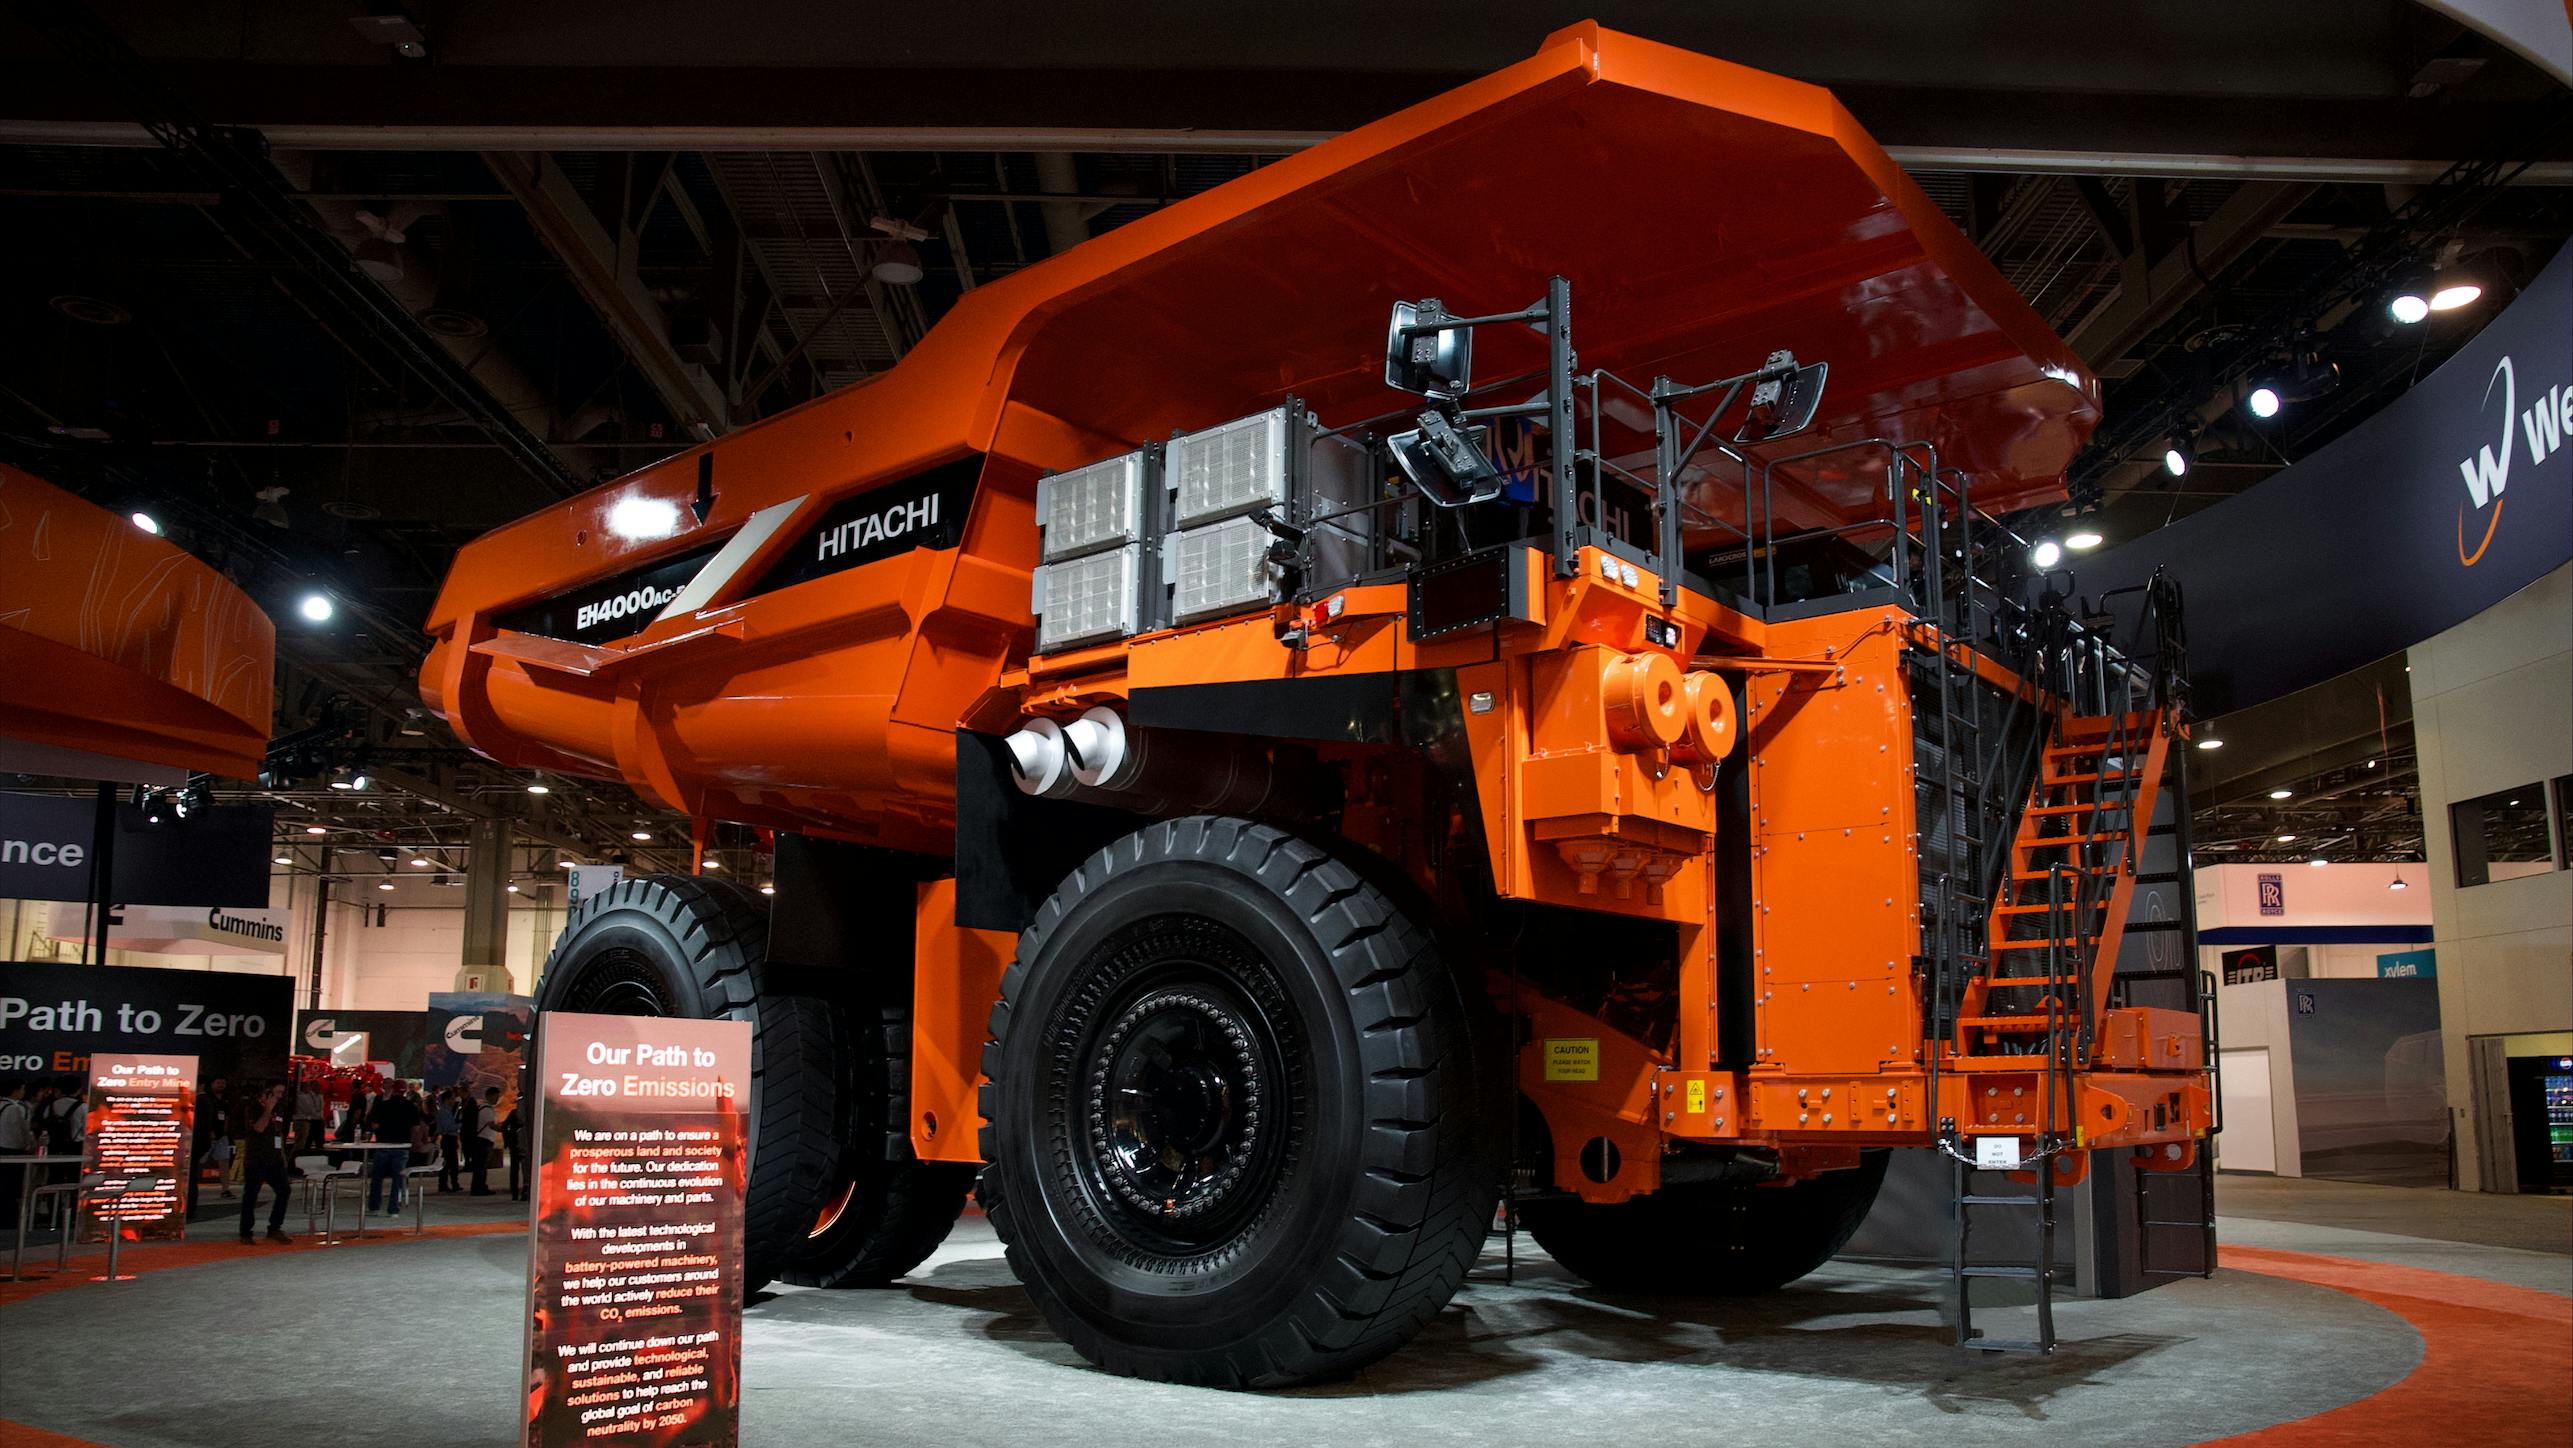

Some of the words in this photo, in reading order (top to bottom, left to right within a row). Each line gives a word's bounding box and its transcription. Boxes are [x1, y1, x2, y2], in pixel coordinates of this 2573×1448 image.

[818, 492, 939, 561] HITACHI
[1, 839, 84, 867] nce
[209, 906, 283, 942] Cummins
[2384, 960, 2417, 978] xylem
[0, 997, 102, 1032] Path
[117, 1003, 162, 1034] to
[174, 1004, 266, 1038] Zero
[587, 1042, 631, 1065] Our
[637, 1044, 687, 1067] Path
[693, 1047, 716, 1068] to
[1553, 1046, 1590, 1054] CAUTION
[112, 1065, 135, 1075] Our
[137, 1065, 165, 1076] Path
[167, 1066, 180, 1076] to
[97, 1077, 127, 1087] Zero
[129, 1078, 160, 1089] Entry
[162, 1079, 191, 1088] Mine
[560, 1073, 617, 1096] Zero
[623, 1075, 735, 1098] Emissions
[574, 1130, 592, 1142] We
[594, 1132, 611, 1141] are
[614, 1131, 628, 1141] on
[630, 1131, 637, 1141] a
[639, 1130, 662, 1143] path
[664, 1130, 675, 1141] to
[677, 1131, 711, 1141] ensure
[712, 1131, 719, 1140] a
[570, 1148, 634, 1159] prosperous
[637, 1146, 660, 1157] land
[662, 1146, 682, 1156] and
[685, 1146, 722, 1157] society
[573, 1163, 589, 1174] for
[590, 1163, 608, 1173] the
[610, 1162, 643, 1173] future.
[645, 1161, 665, 1172] Our
[667, 1161, 719, 1172] dedication
[566, 1179, 585, 1190] lies
[588, 1179, 598, 1189] in
[600, 1178, 618, 1189] the
[619, 1177, 676, 1189] continuous
[678, 1176, 723, 1187] evolution
[574, 1195, 587, 1207] of
[588, 1196, 606, 1206] our
[609, 1194, 662, 1206] machinery
[664, 1192, 684, 1203] and
[686, 1192, 714, 1206] parts.
[571, 1228, 596, 1240] With
[599, 1227, 616, 1239] the
[618, 1225, 647, 1238] latest
[649, 1222, 715, 1237] technological
[601, 1241, 675, 1255] developments
[677, 1239, 686, 1250] in
[565, 1257, 659, 1274] battery-powered
[661, 1254, 718, 1267] machinery,
[563, 1279, 580, 1290] we
[582, 1277, 606, 1290] help
[608, 1277, 627, 1287] our
[628, 1271, 682, 1285] customers
[684, 1268, 719, 1280] around
[561, 1295, 579, 1307] the
[582, 1292, 612, 1305] world
[614, 1289, 655, 1303] actively
[656, 1287, 693, 1300] reduce
[695, 1284, 720, 1296] their
[625, 1304, 683, 1319] emissions.
[558, 1345, 577, 1358] We
[578, 1343, 597, 1355] will
[599, 1339, 645, 1354] continue
[646, 1336, 676, 1350] down
[677, 1334, 694, 1345] our
[696, 1330, 719, 1345] path
[567, 1360, 589, 1374] and
[591, 1357, 632, 1372] provide
[633, 1347, 709, 1366] technological,
[572, 1371, 641, 1390] sustainable,
[642, 1368, 663, 1381] and
[665, 1363, 704, 1378] reliable
[567, 1390, 620, 1407] solutions
[622, 1388, 634, 1400] to
[636, 1385, 659, 1399] help
[660, 1381, 689, 1395] reach
[691, 1379, 708, 1391] the
[581, 1405, 615, 1424] global
[617, 1403, 641, 1419] goal
[642, 1401, 654, 1413] of
[655, 1397, 693, 1412] carbon
[586, 1419, 640, 1438] neutrality
[643, 1416, 657, 1430] by
[658, 1413, 687, 1427] 2050.
